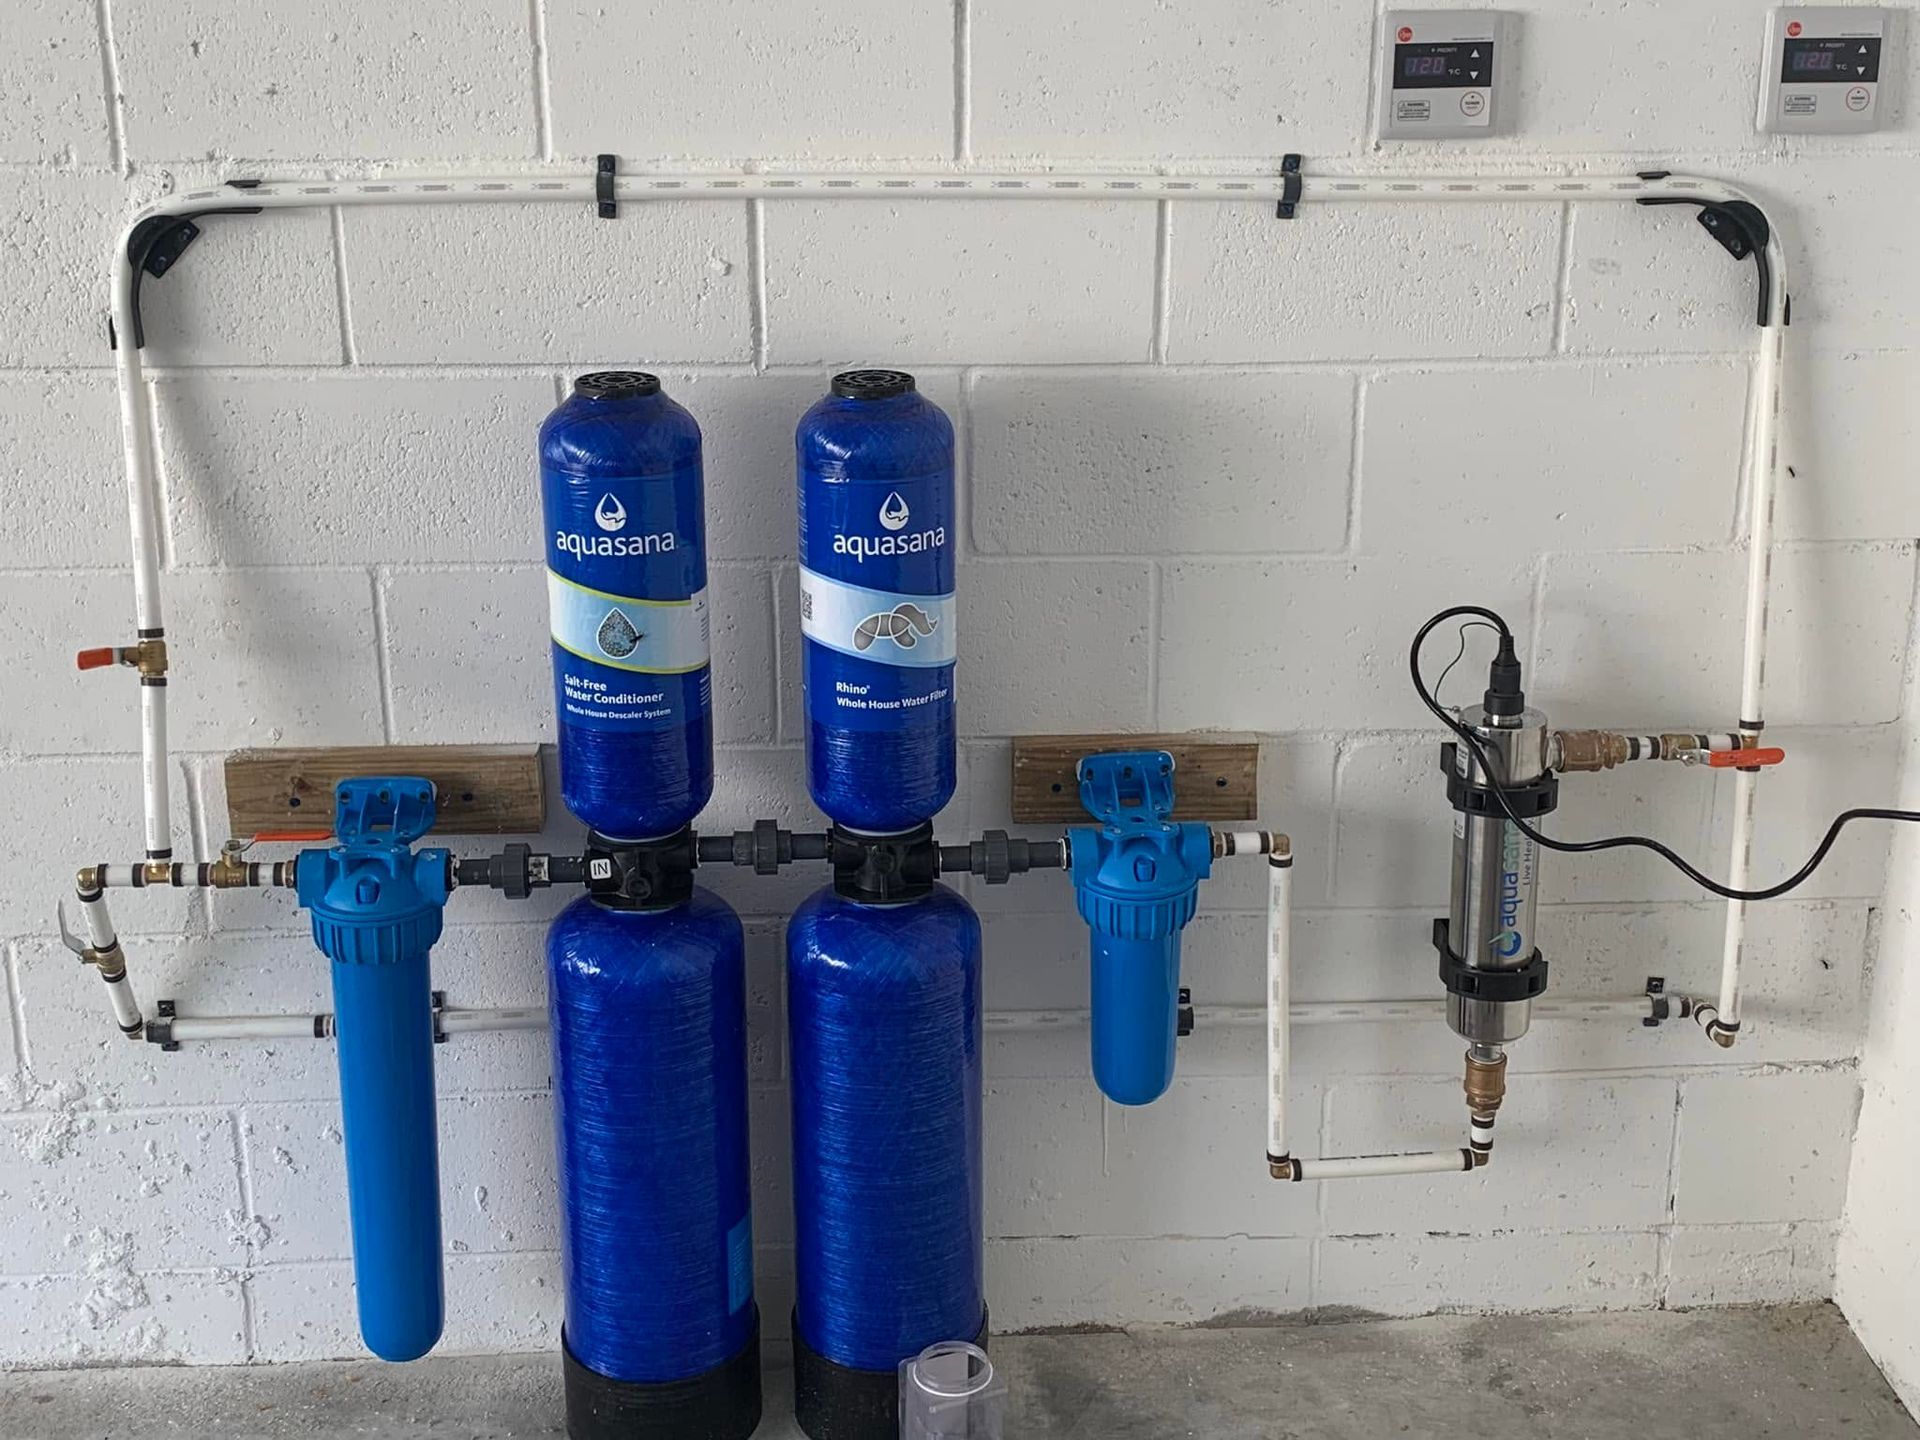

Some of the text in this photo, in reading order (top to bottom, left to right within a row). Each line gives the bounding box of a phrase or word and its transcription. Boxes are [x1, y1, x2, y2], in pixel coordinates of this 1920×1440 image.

[556, 530, 675, 562] aquasana
[833, 526, 945, 563] aquasana
[564, 673, 607, 691] Salt-Free
[565, 686, 664, 704] Water Conditioner
[837, 688, 948, 709] Whole House Water Filter
[566, 703, 672, 720] Whole House Descaler System
[594, 861, 608, 876] IN
[1523, 864, 1533, 886] Live
